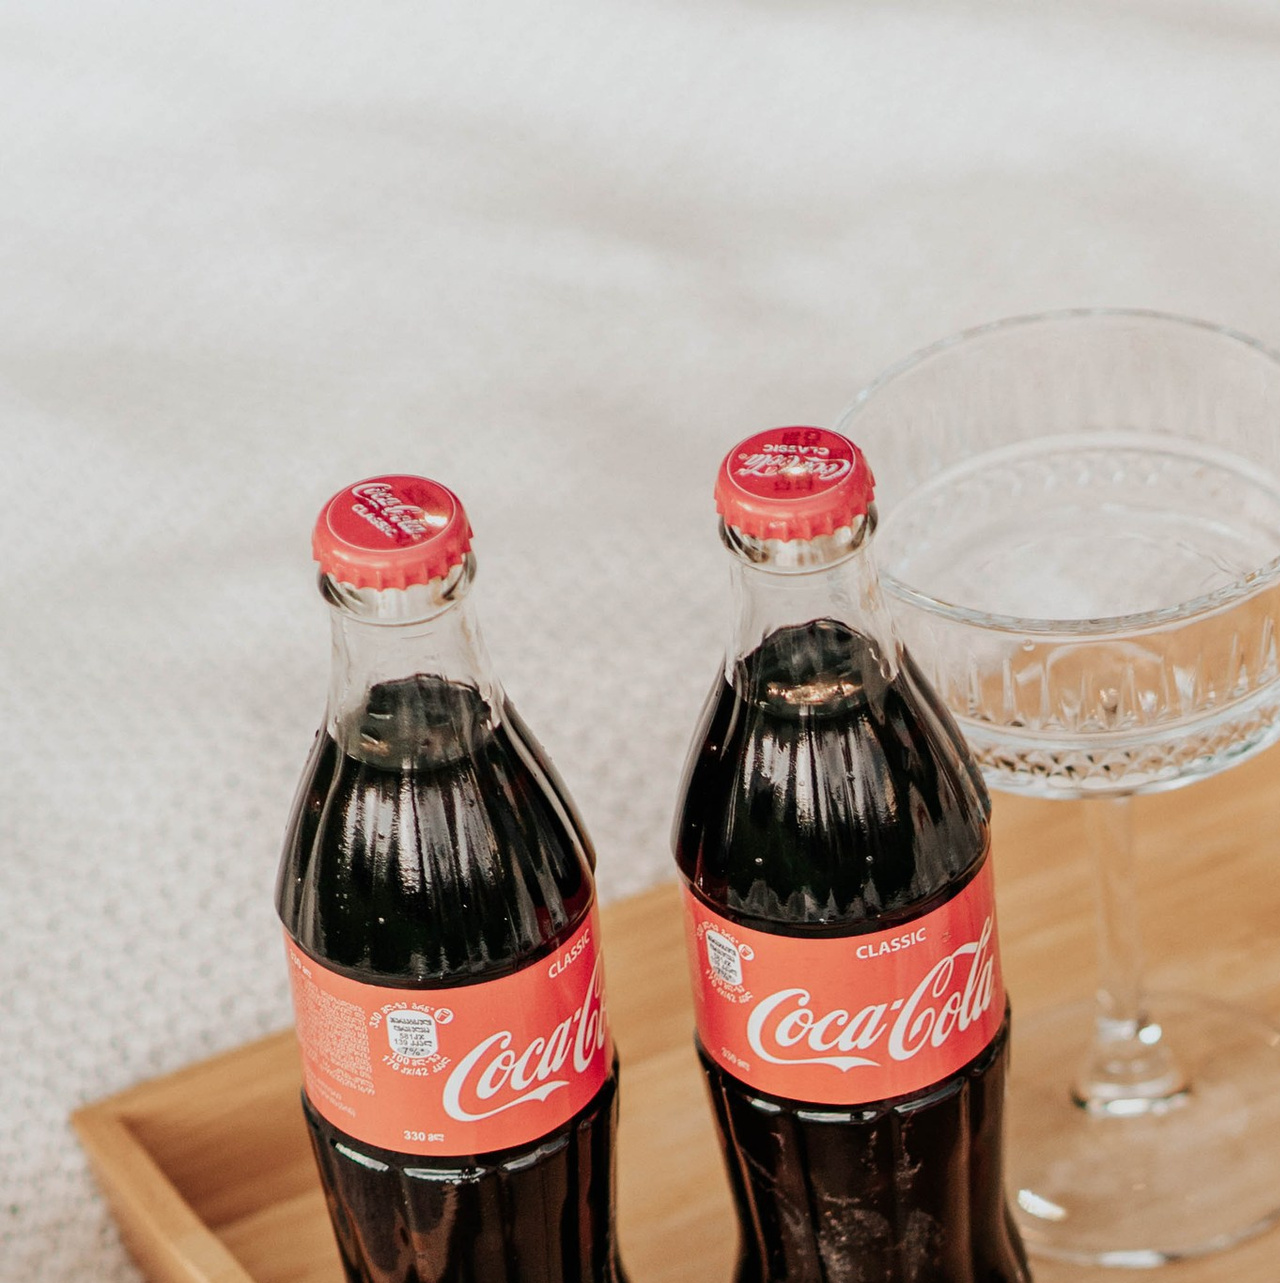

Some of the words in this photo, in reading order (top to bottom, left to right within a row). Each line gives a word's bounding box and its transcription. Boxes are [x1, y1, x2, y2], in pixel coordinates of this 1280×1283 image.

[762, 443, 830, 456] CLASSIC
[351, 503, 398, 539] CLASSIC
[548, 928, 591, 979] CLASSIC
[855, 927, 926, 960] CLASSIC
[747, 914, 994, 1073] Coca-Cola
[382, 1055, 401, 1071] 176
[391, 1051, 411, 1065] 100
[403, 1130, 427, 1142] 330
